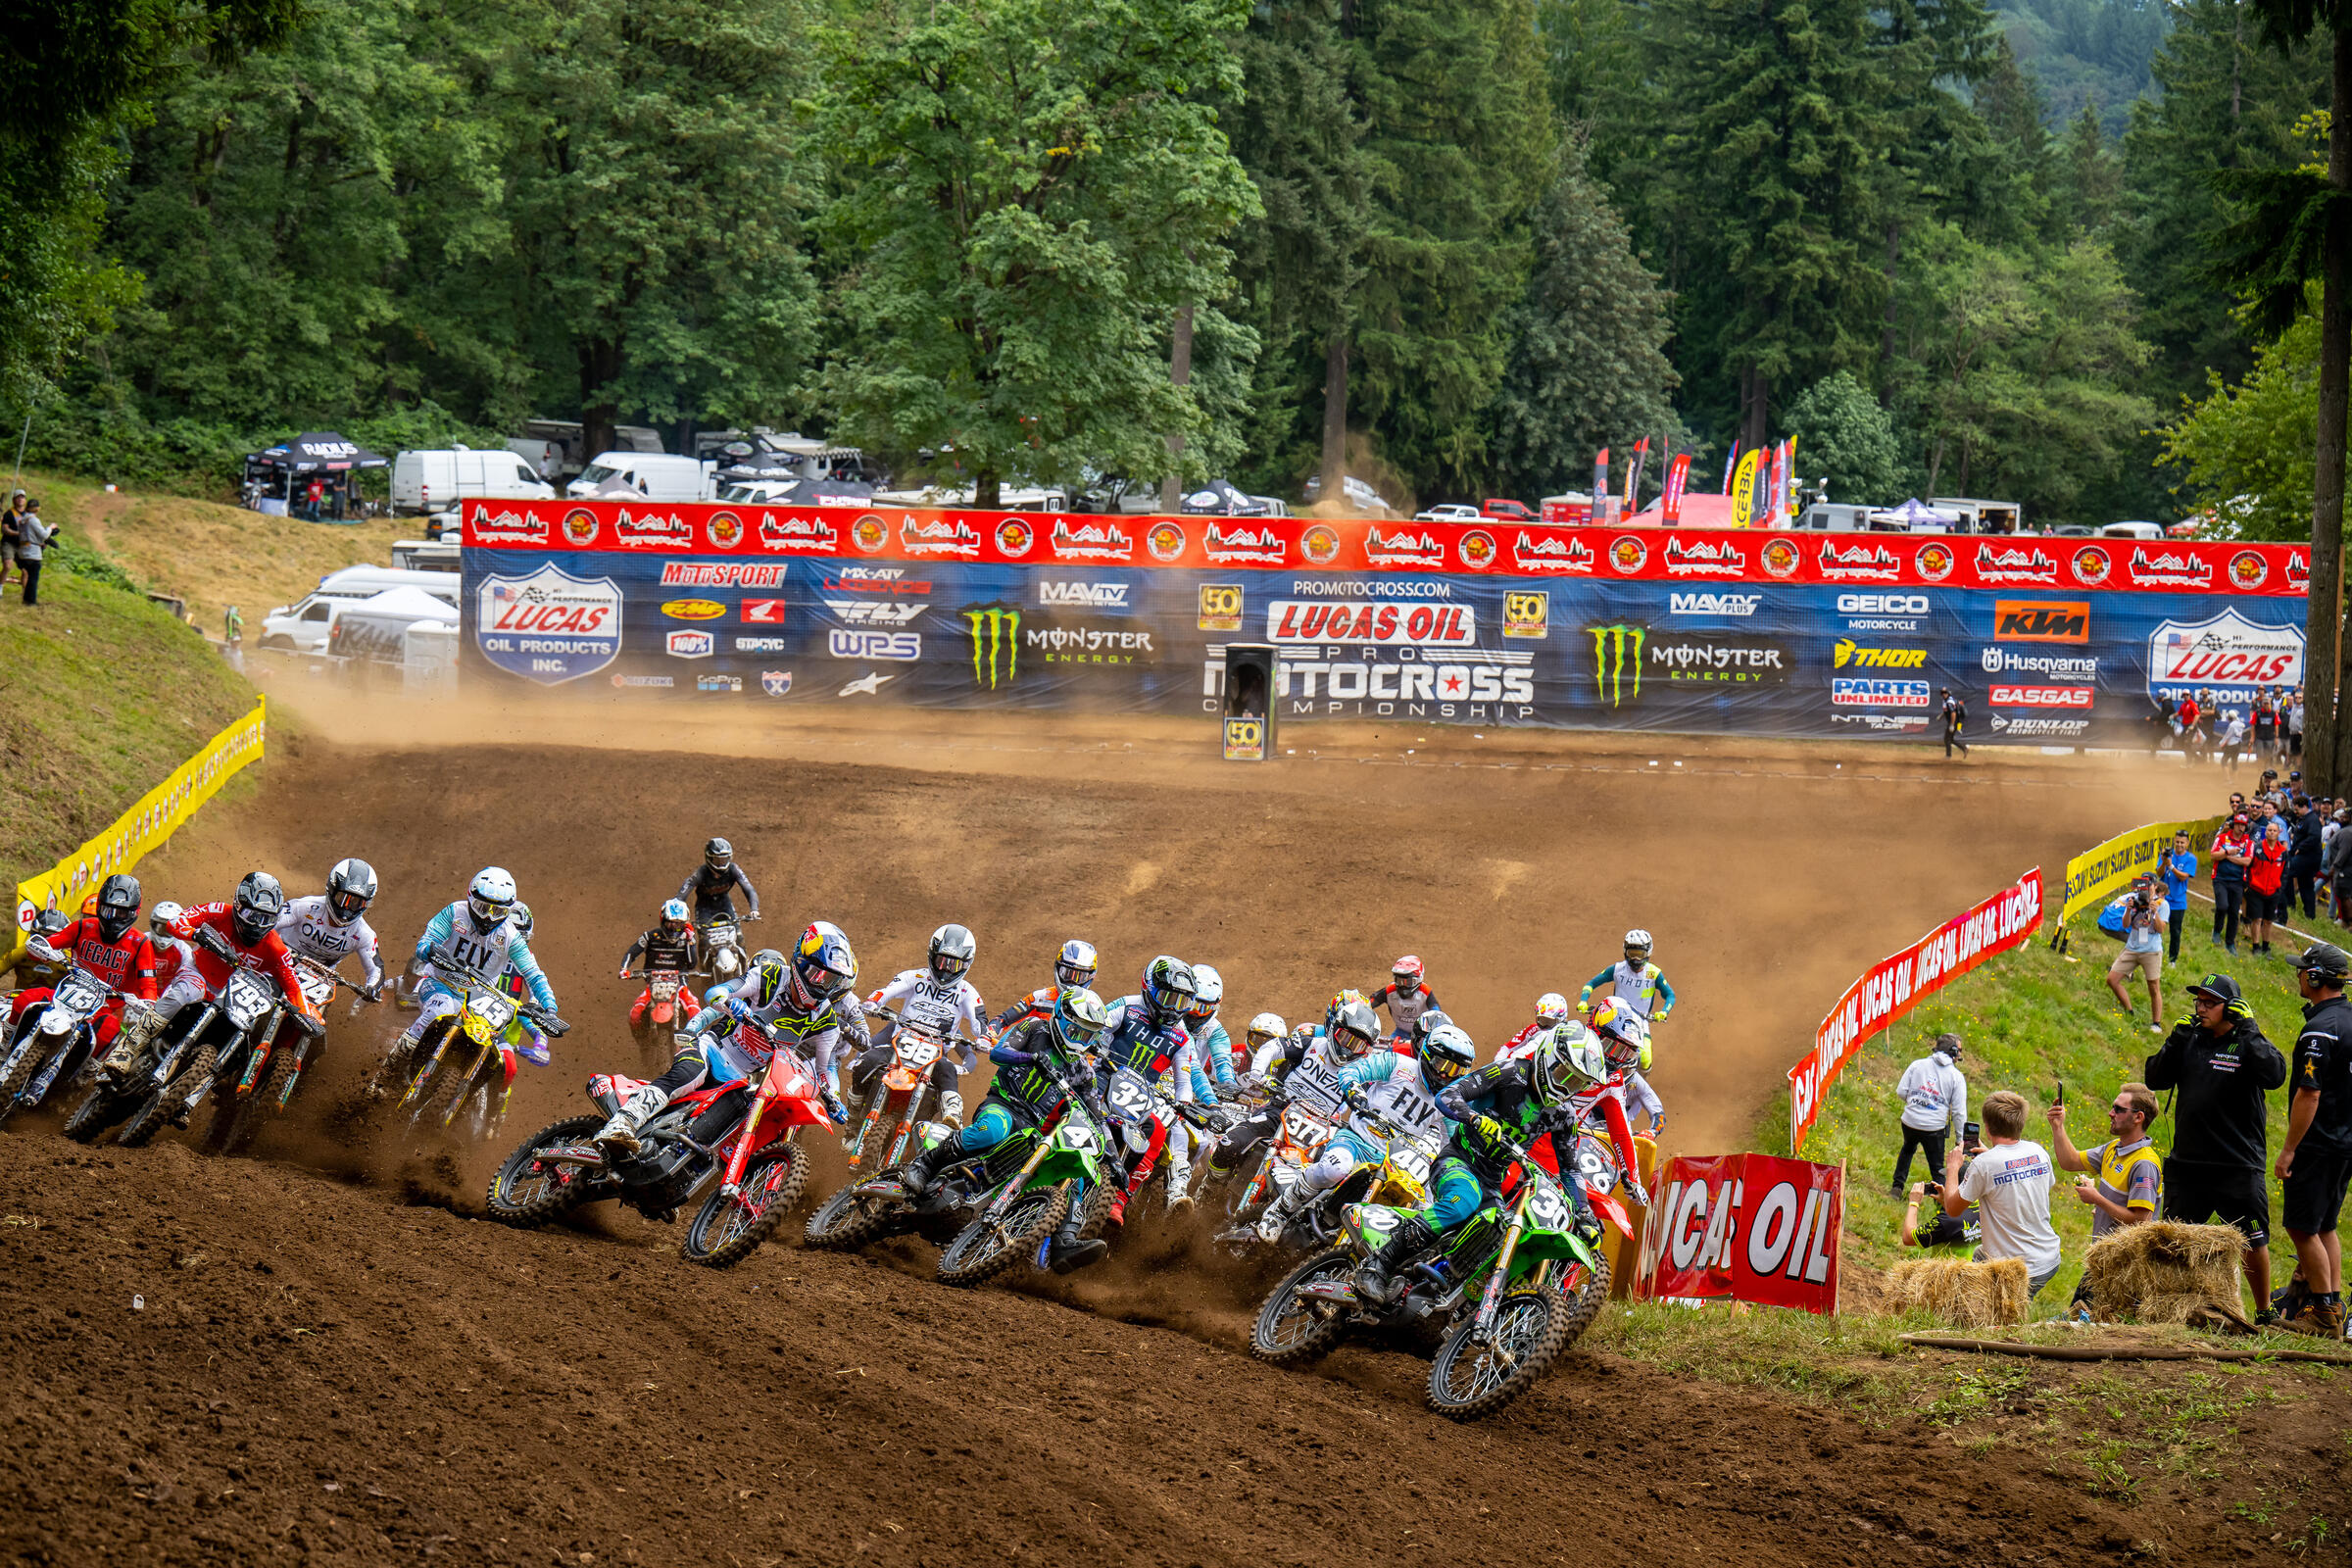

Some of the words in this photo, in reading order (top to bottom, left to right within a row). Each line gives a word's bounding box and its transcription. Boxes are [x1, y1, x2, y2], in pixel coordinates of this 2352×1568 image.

[823, 599, 930, 621] FLY
[1206, 588, 1239, 614] 50
[1510, 595, 1544, 620] 50
[1726, 604, 1749, 613] PLUS
[1837, 594, 1930, 613] GEICO
[494, 604, 610, 633] LUCAS
[1276, 605, 1399, 640] LUCAS
[1407, 607, 1467, 641] OIL
[1848, 619, 1917, 630] MOTORCYCLE
[1998, 608, 2085, 636] KTM
[486, 638, 514, 653] OIL
[519, 639, 612, 655] PRODUCTS
[671, 636, 709, 653] 100%
[830, 630, 920, 660] WPS
[1026, 626, 1154, 652] MONSTER
[532, 659, 567, 672] INC.
[1045, 653, 1134, 664] ENERGY
[1327, 646, 1416, 662] PRO
[1651, 643, 1784, 669] MONSTER
[1854, 648, 1928, 668] THOR
[2004, 653, 2096, 673] Husqvarna
[697, 674, 742, 684] GoPro
[1671, 670, 1762, 682] ENERGY
[2166, 652, 2293, 682] LUCAS
[1834, 680, 1929, 696] PARTS
[1834, 694, 1928, 705] UNLIMITED
[1991, 688, 2090, 705] GASGAS
[1202, 698, 1534, 719] CMPIONSHIP
[1831, 713, 1930, 725] INTENSE
[1231, 722, 1259, 744] 50
[2010, 718, 2089, 729] DUNLOP
[2110, 845, 2133, 875] SUZUKI
[21, 907, 36, 924] D
[79, 940, 131, 972] LEGACY
[453, 936, 493, 970] FLY
[106, 971, 123, 989] 113
[1861, 966, 1894, 1029] LUCAS
[1894, 956, 1913, 1006] OIL
[56, 982, 98, 1011] 113
[228, 977, 271, 1018] 793
[466, 995, 510, 1028] 43
[900, 1036, 938, 1065] 38
[1111, 1080, 1153, 1122] 32
[1391, 1086, 1437, 1128] FLY
[1285, 1110, 1328, 1146] 377
[1329, 1153, 1342, 1166] FLY
[1389, 1148, 1432, 1184] 40
[2007, 1157, 2028, 1169] LUCAS
[2027, 1154, 2040, 1166] OIL
[1580, 1152, 1612, 1196] 96
[1360, 1205, 1399, 1231] 30
[1530, 1187, 1570, 1231] 30
[1747, 1181, 1833, 1286] OIL
